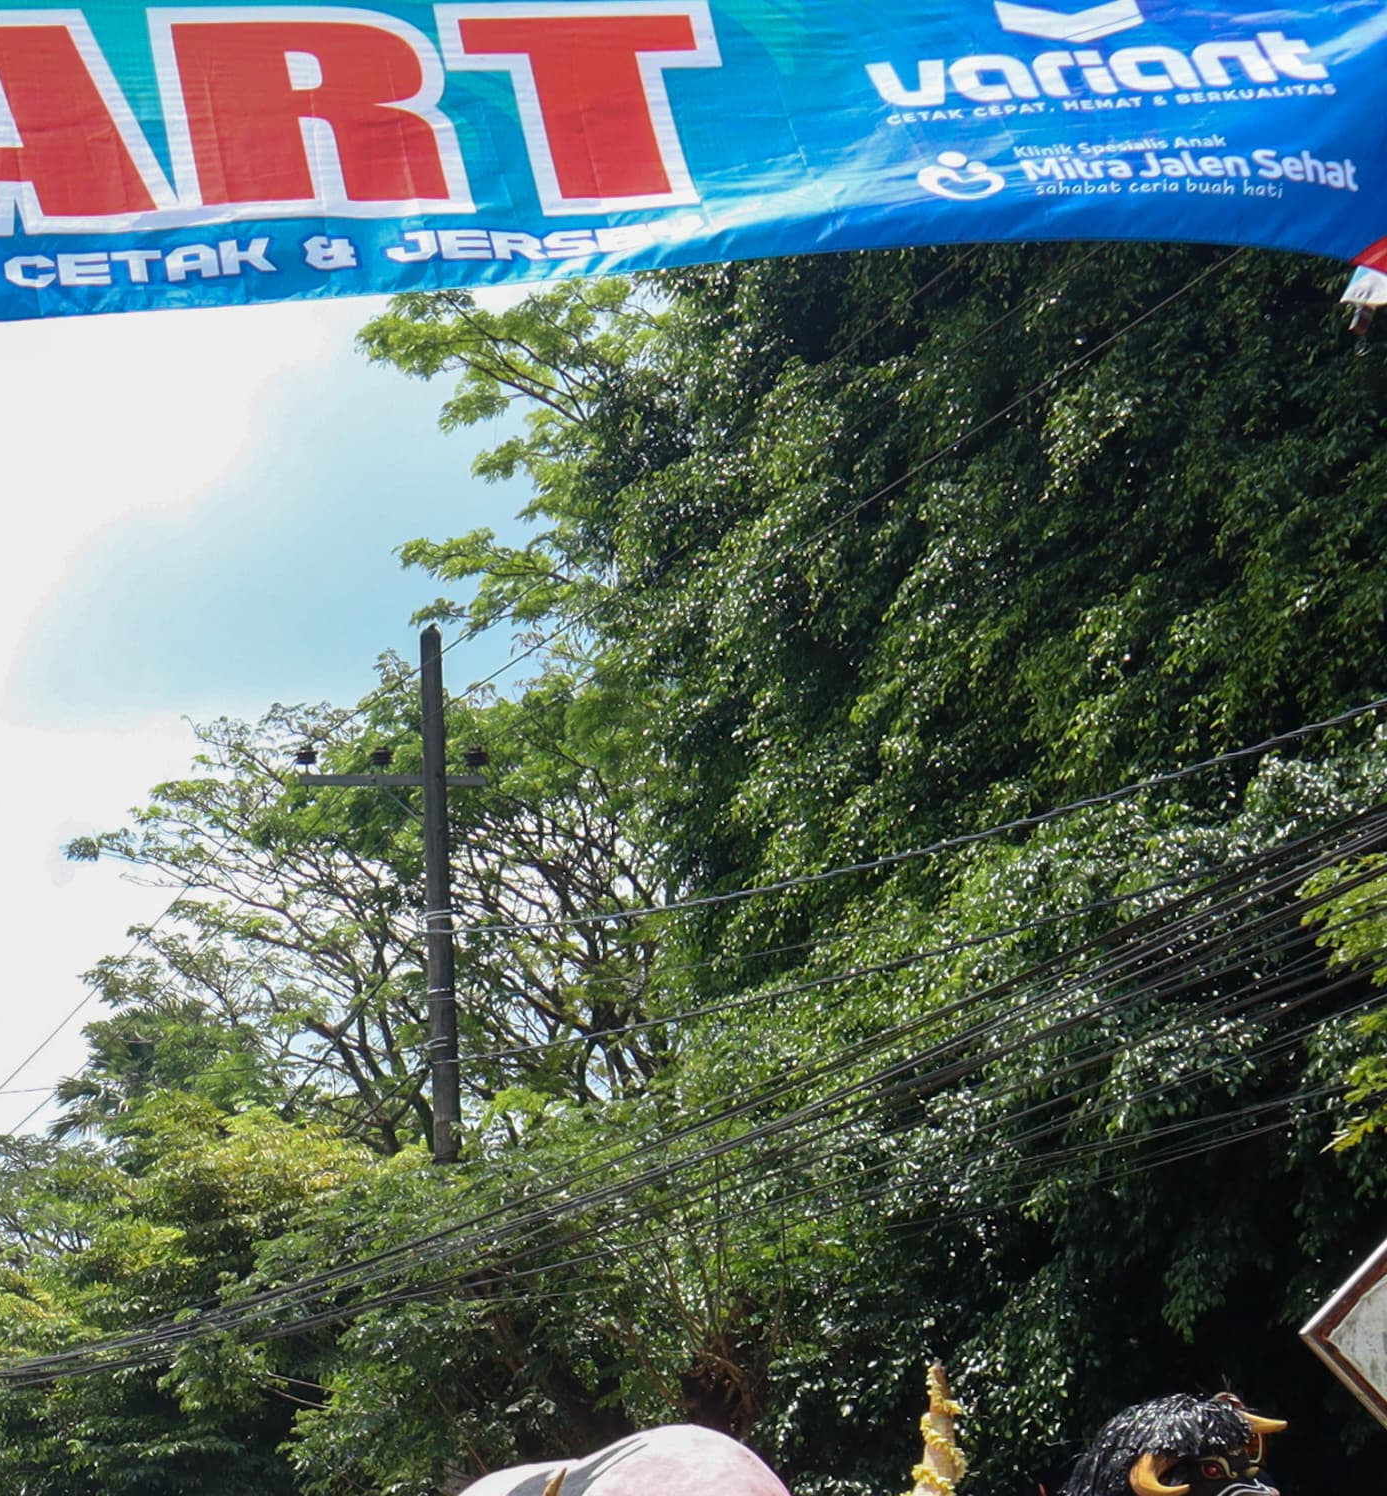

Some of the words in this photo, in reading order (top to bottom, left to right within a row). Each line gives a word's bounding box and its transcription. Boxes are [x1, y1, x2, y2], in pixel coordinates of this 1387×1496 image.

[864, 30, 1329, 107] variant
[885, 108, 963, 126] CETAK
[1063, 95, 1142, 112] HEMAT
[1152, 94, 1167, 107] &
[1176, 83, 1337, 106] BERKUALITAS
[1013, 143, 1072, 159] Klinik
[1173, 134, 1227, 149] Anak
[1020, 153, 1132, 181] Mitra
[1138, 149, 1248, 179] Jalen
[1257, 149, 1359, 191] Sehat
[1035, 181, 1121, 196] sahabat
[1128, 180, 1180, 194] ceria
[1186, 178, 1235, 194] buah
[1242, 178, 1283, 198] hati
[4, 237, 279, 288] CETAK
[303, 237, 356, 270] &
